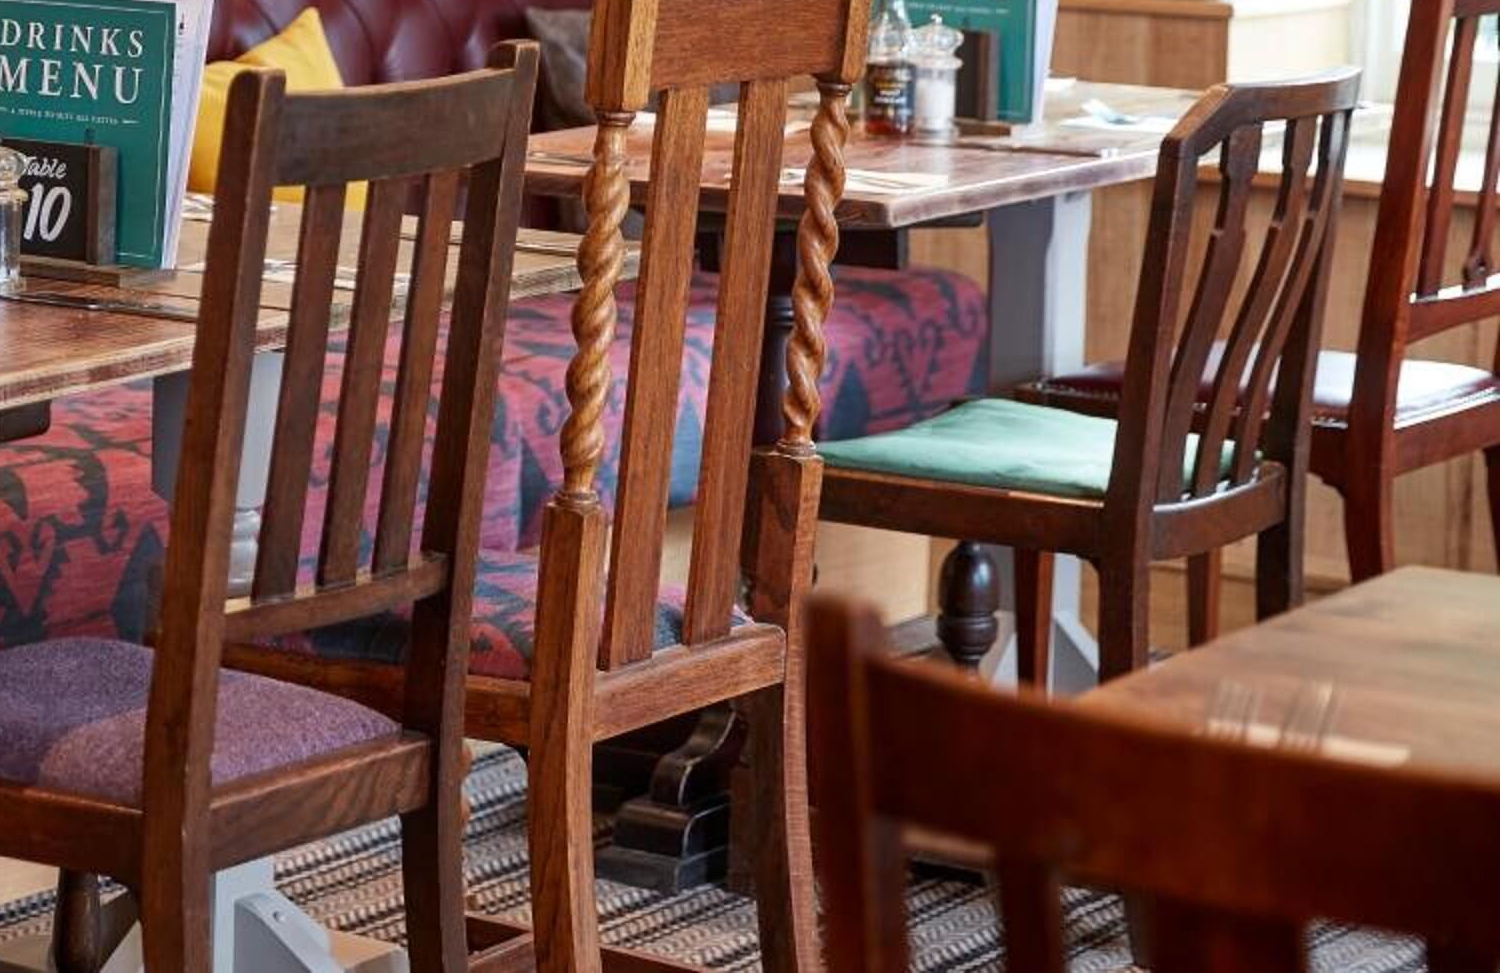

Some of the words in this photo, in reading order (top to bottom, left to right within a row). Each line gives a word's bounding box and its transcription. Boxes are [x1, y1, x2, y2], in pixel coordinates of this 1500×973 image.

[0, 18, 144, 58] DRINKS
[22, 156, 68, 179] Table
[23, 183, 71, 241] 10
